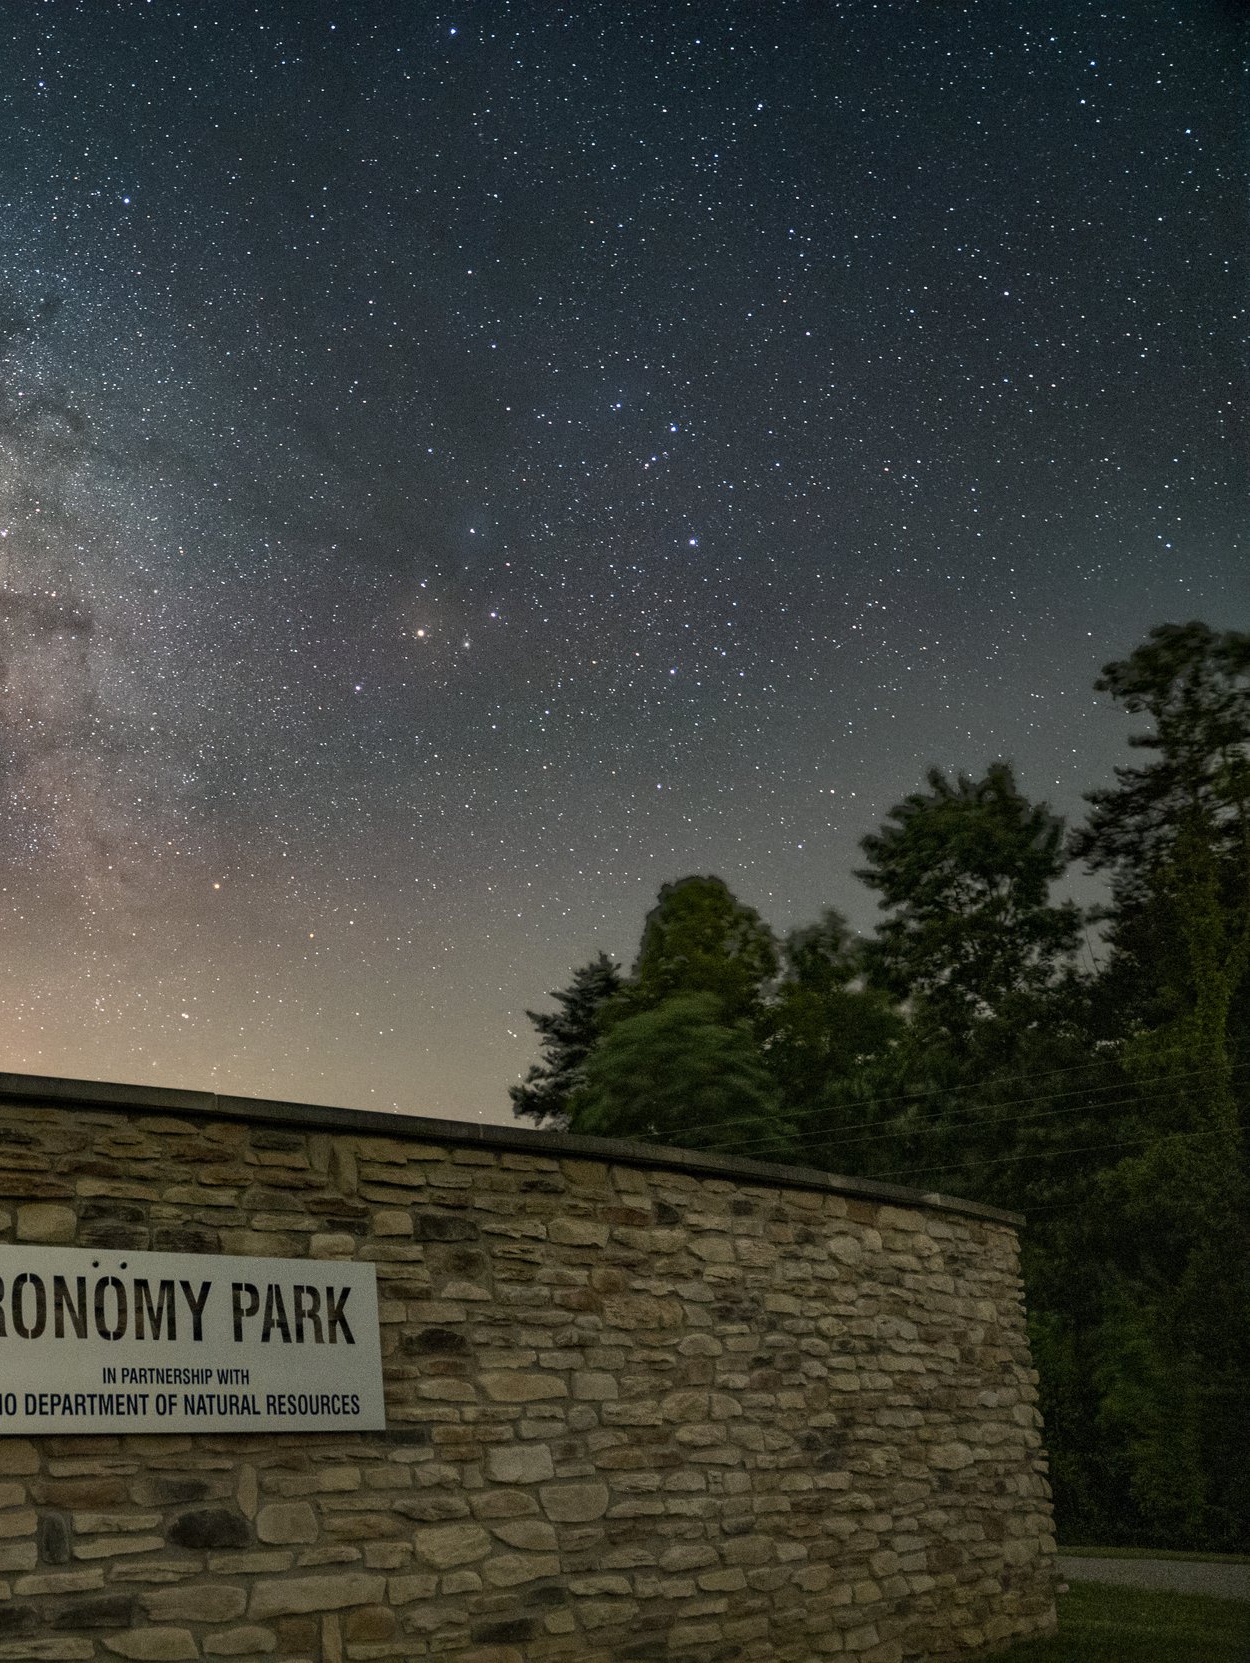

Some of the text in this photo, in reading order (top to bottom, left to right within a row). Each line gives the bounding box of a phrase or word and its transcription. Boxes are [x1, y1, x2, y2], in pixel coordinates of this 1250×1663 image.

[232, 1282, 355, 1344] PARK
[103, 1368, 249, 1385] IN PARTNERSHIP WITH
[25, 1394, 149, 1415] DEPARTMENT
[156, 1394, 177, 1416] OF
[184, 1394, 261, 1415] NATURAL
[266, 1394, 360, 1415] RESOURCES
